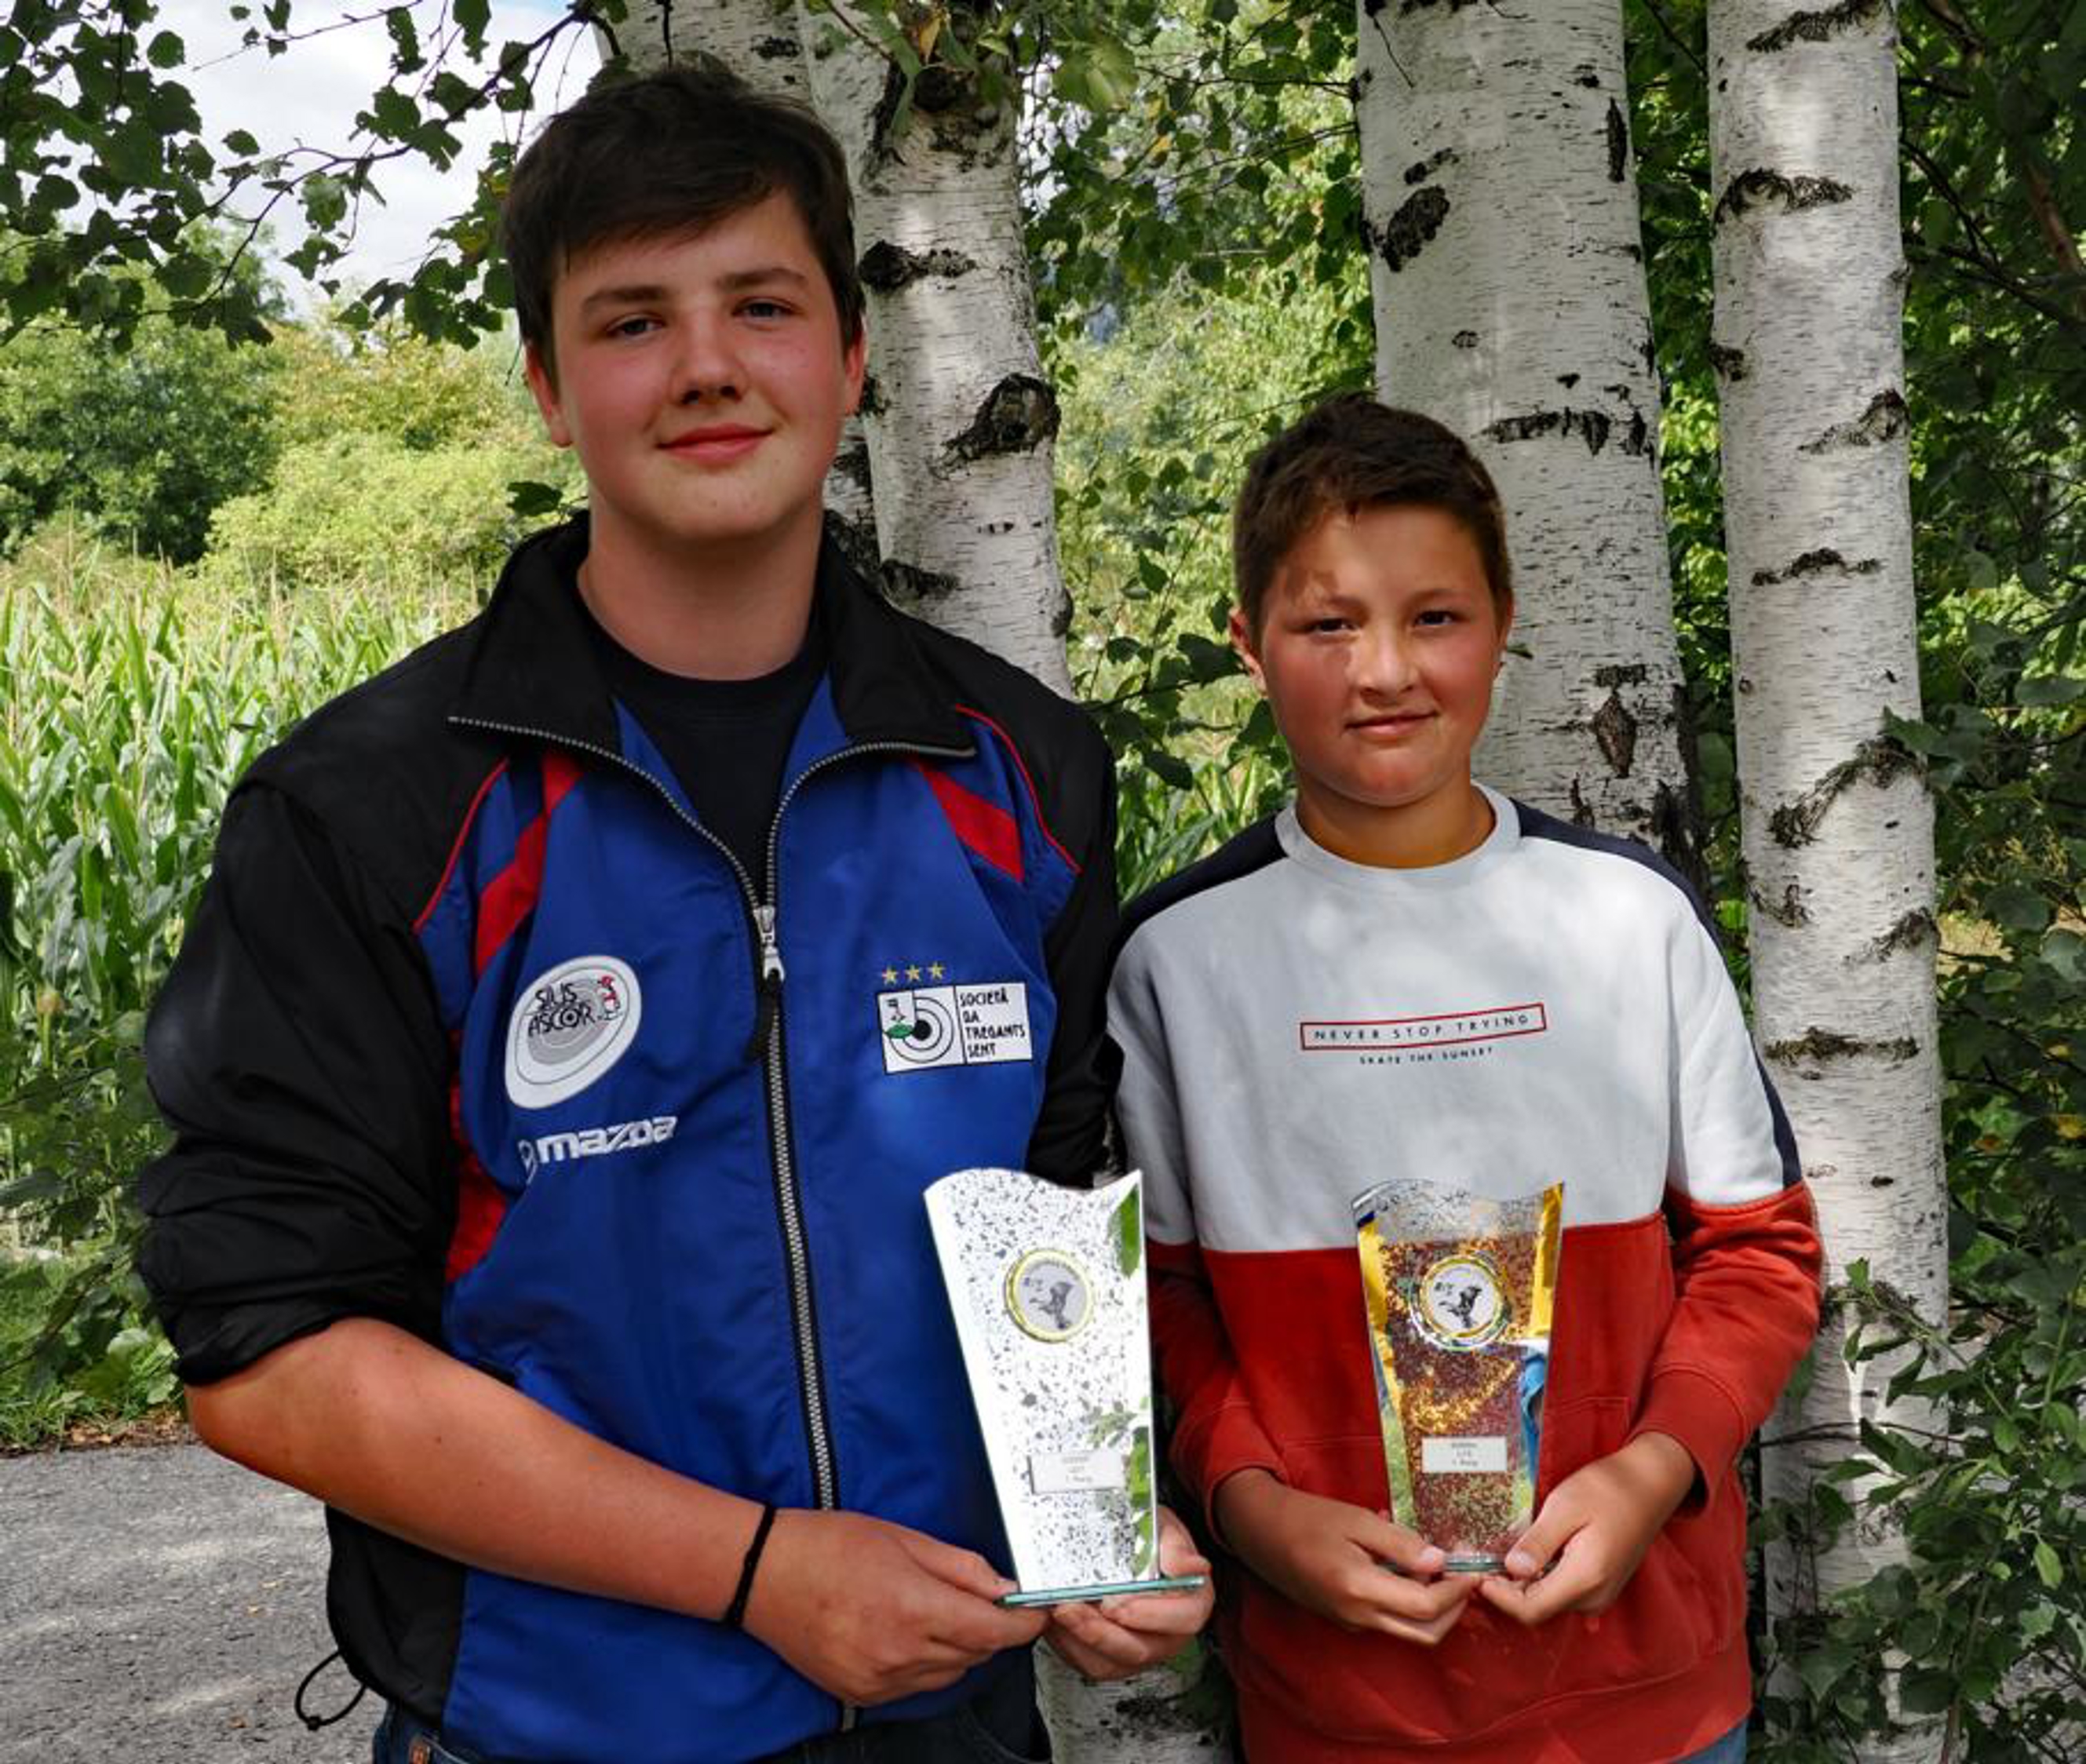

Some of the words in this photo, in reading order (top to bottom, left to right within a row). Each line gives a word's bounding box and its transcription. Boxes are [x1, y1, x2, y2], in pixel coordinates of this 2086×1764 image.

[528, 1000, 596, 1037] ASCOR
[1314, 1029, 1379, 1040] NEVER
[1393, 1026, 1442, 1039] STOP
[1456, 1015, 1529, 1032] TRYING
[967, 1042, 996, 1059] SENT
[1359, 1055, 1401, 1065] SKATE
[1410, 1053, 1433, 1062] THE
[1442, 1047, 1493, 1060] SUNSET
